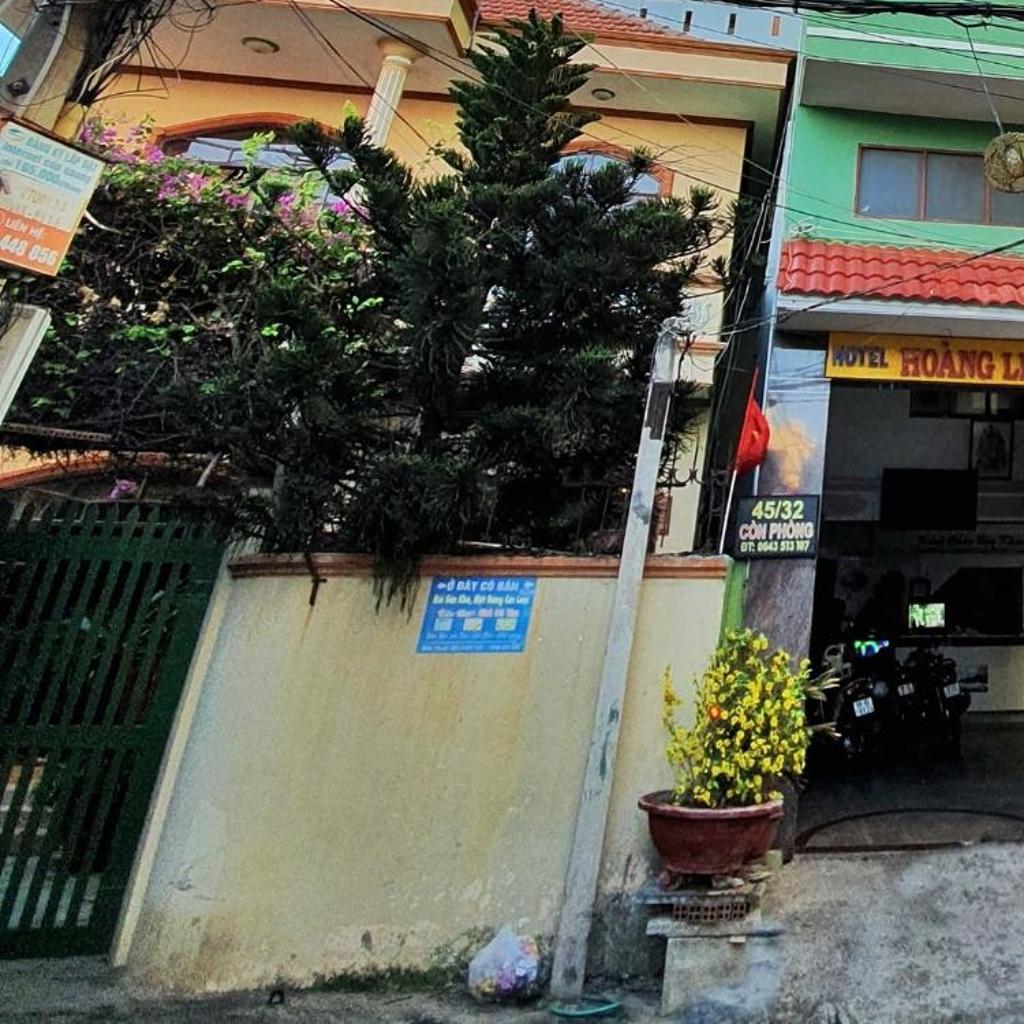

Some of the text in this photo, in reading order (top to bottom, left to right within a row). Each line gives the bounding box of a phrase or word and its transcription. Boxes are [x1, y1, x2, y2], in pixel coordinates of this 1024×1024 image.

[832, 345, 888, 368] HOTEL
[752, 500, 804, 520] 45/32
[739, 519, 814, 540] CÒN PHÒNG
